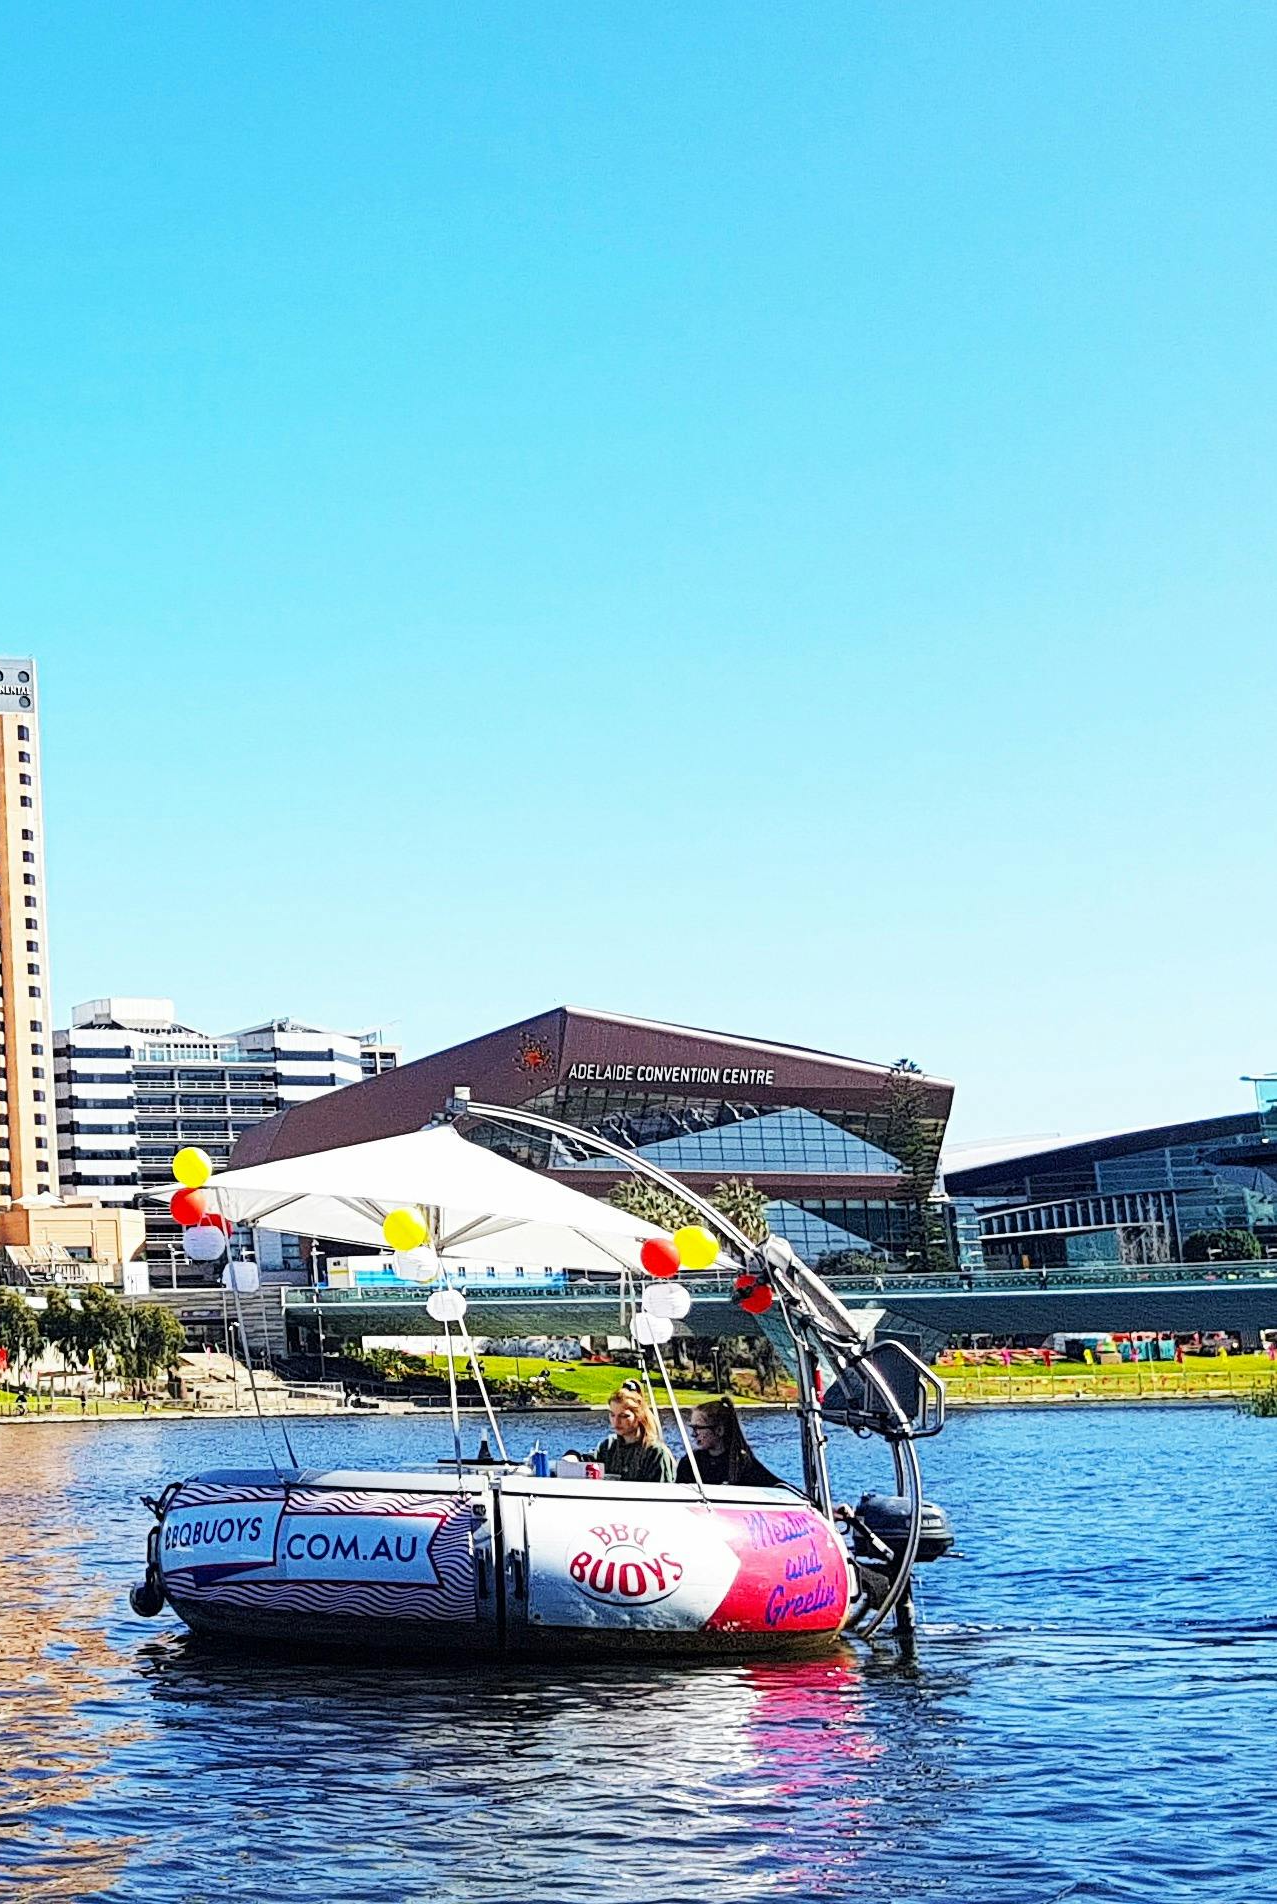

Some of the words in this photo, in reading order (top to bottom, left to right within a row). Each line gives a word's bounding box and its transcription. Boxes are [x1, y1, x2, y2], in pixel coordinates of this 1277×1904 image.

[569, 1063, 634, 1081] ADELAIDE
[637, 1065, 719, 1084] CONVENTION
[722, 1068, 775, 1085] CENTRE
[281, 1533, 418, 1563] .COM.AU
[589, 1522, 651, 1547] BBQ
[569, 1550, 684, 1597] BUOYS
[785, 1538, 824, 1582] and
